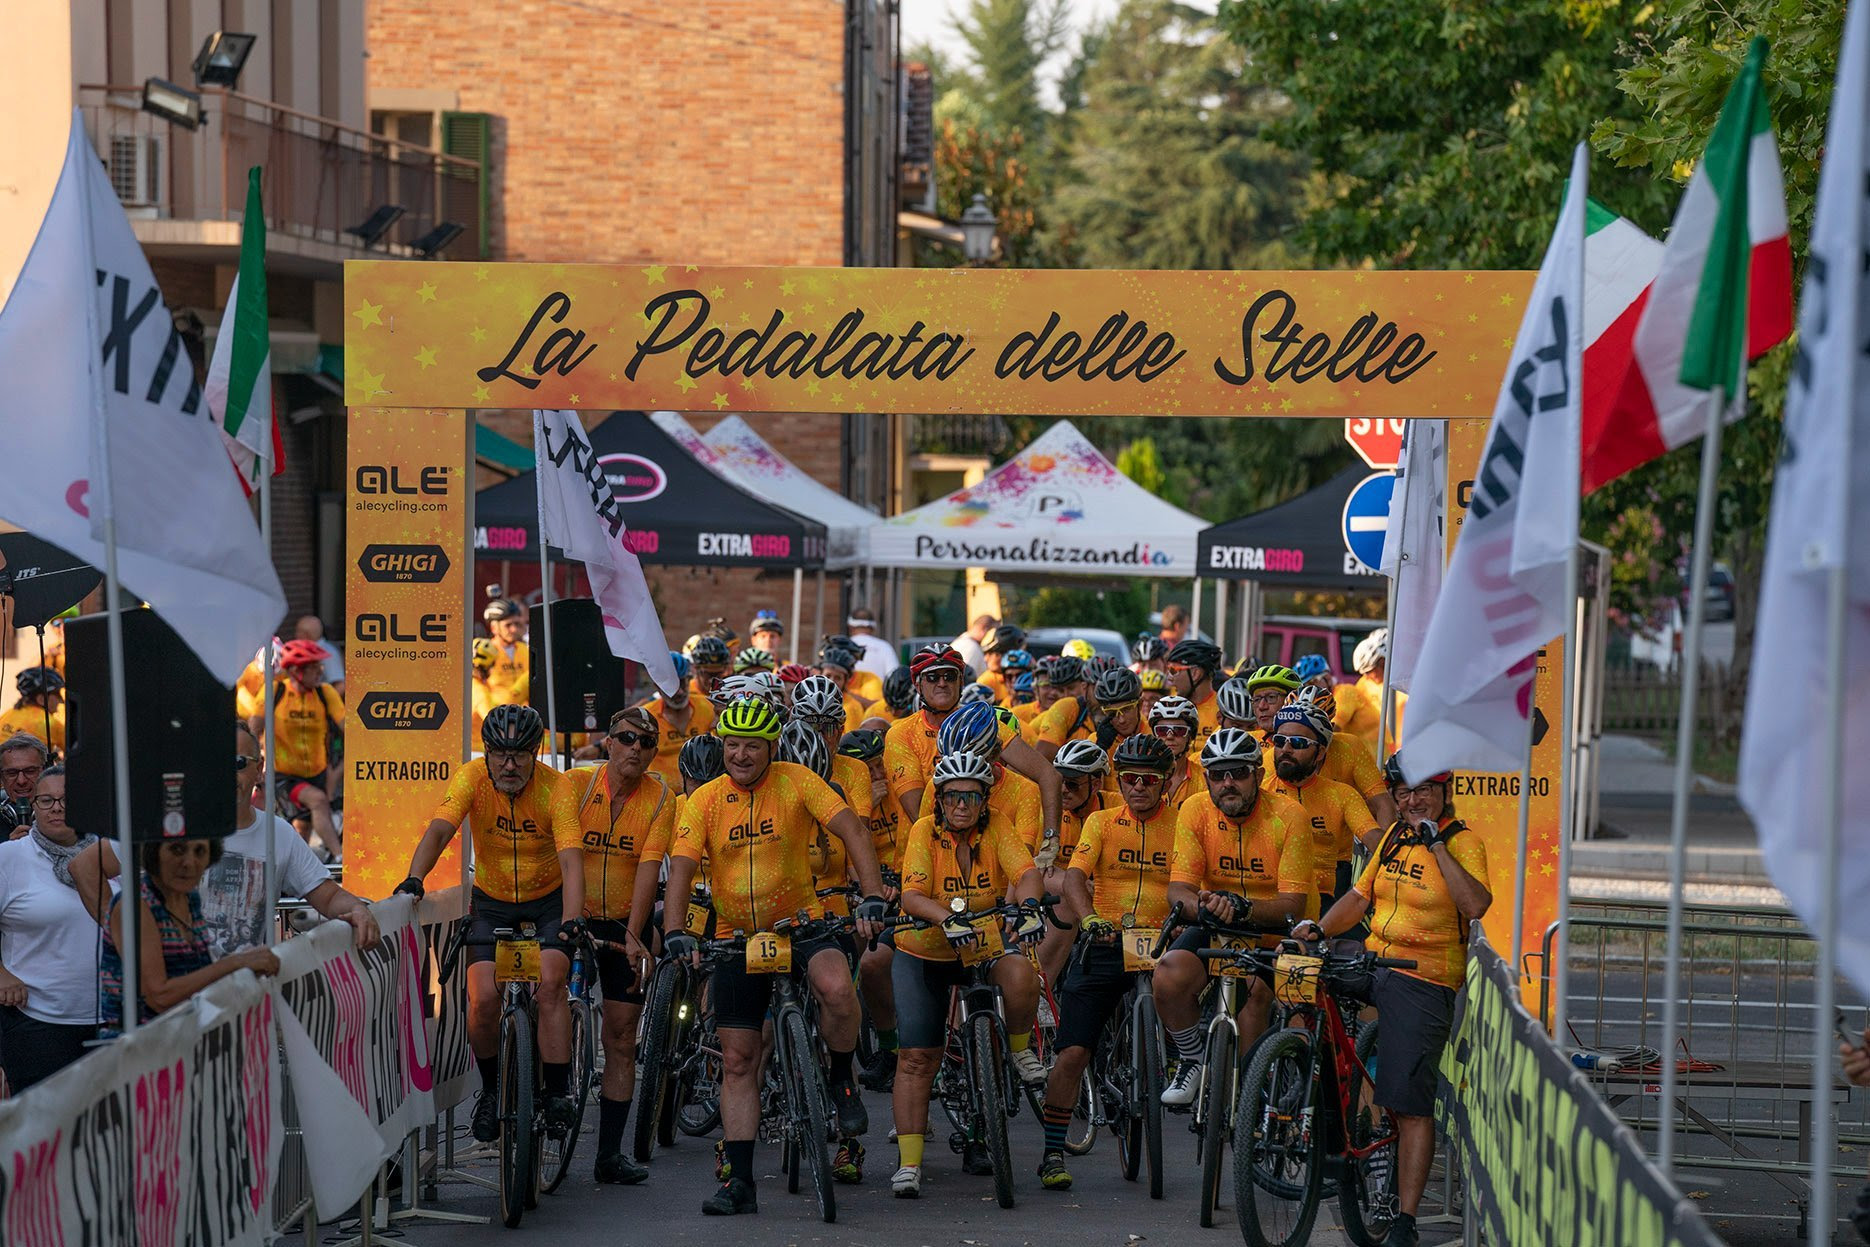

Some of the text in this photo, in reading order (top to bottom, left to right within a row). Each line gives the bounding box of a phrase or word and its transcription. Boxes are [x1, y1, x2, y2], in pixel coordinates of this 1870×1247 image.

[476, 289, 1438, 390] La Pedalata delle Stelle
[355, 500, 448, 513] alecycling.com
[698, 533, 790, 557] EXTRAGIRO
[915, 535, 1174, 567] Personalizzandia
[1210, 545, 1304, 573] EXTRAGIRO
[355, 648, 447, 660] alecycling.com
[1277, 711, 1303, 721] GIOS
[355, 761, 450, 781] EXTRAGIRO
[1454, 776, 1549, 797] EXTRAGRO
[760, 941, 777, 958] 15
[1136, 937, 1152, 956] 67
[513, 951, 522, 968] 3
